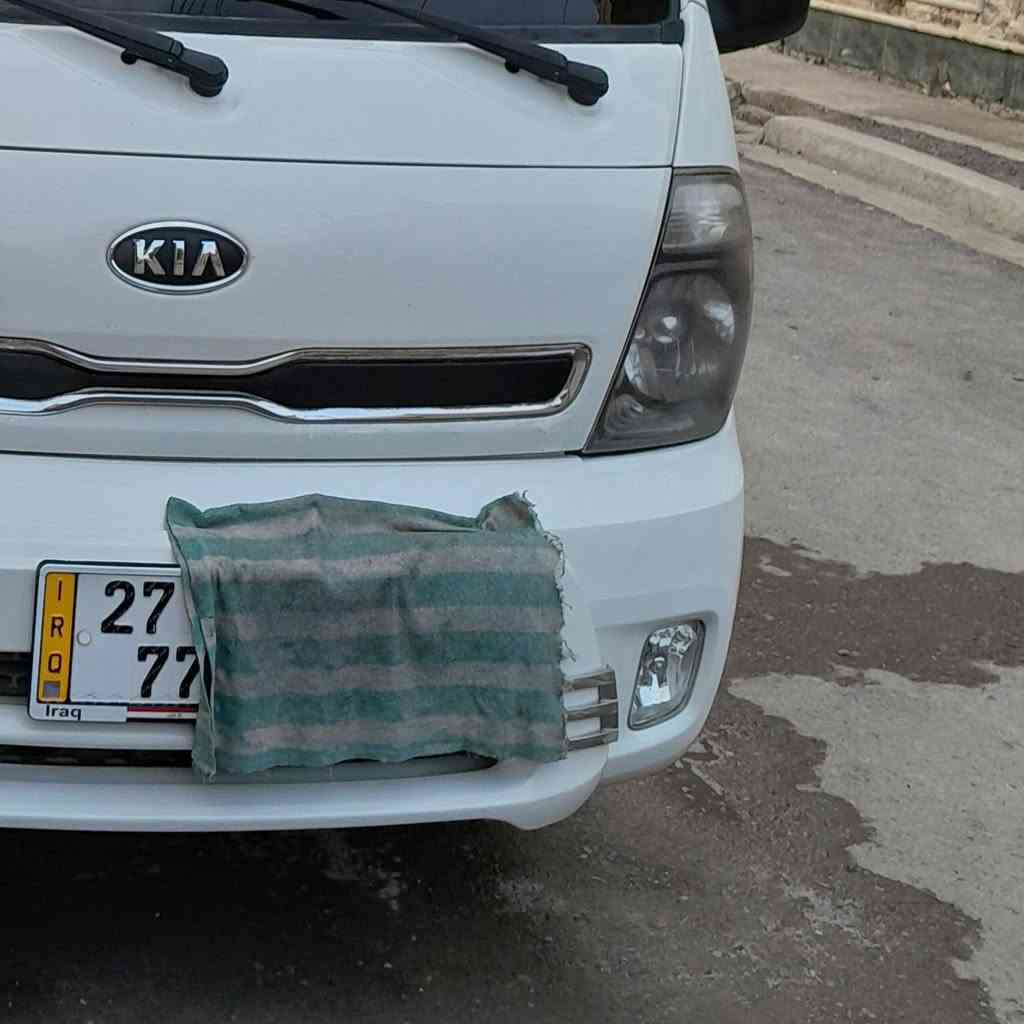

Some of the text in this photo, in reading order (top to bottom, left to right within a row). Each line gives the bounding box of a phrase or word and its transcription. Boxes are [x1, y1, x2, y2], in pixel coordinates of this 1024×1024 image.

[133, 239, 226, 277] KIA
[100, 580, 175, 635] 27
[45, 705, 83, 721] Iraq
